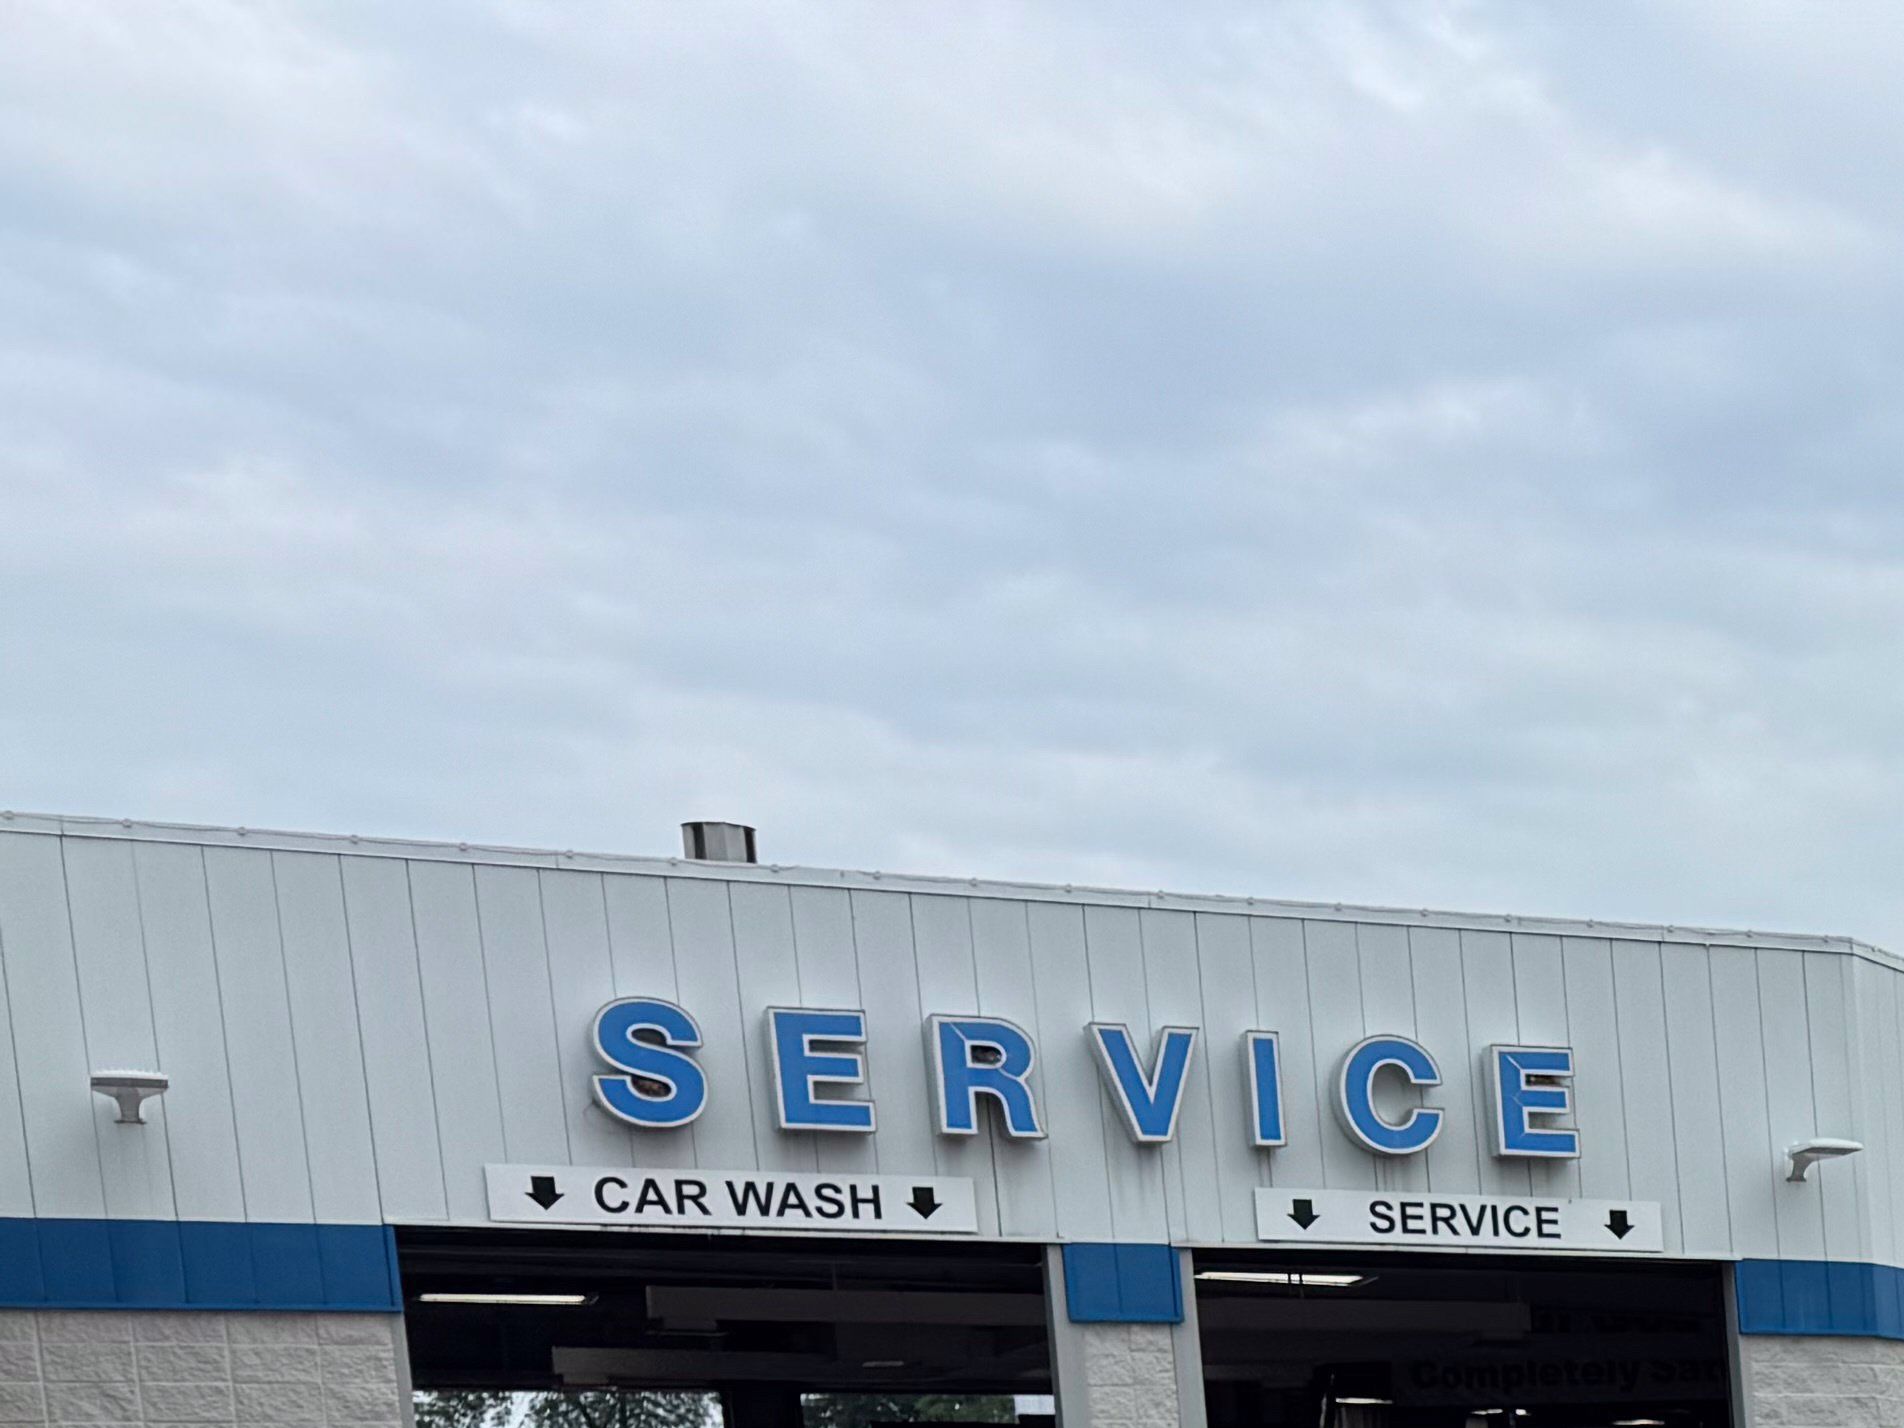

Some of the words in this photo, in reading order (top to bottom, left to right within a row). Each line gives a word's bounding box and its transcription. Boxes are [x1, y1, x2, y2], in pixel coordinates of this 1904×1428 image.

[593, 996, 1582, 1160] SERVICE
[594, 1176, 712, 1216] CAR
[725, 1180, 883, 1220] WASH
[1369, 1200, 1562, 1239] SERVICE
[1412, 1359, 1640, 1393] Completely
